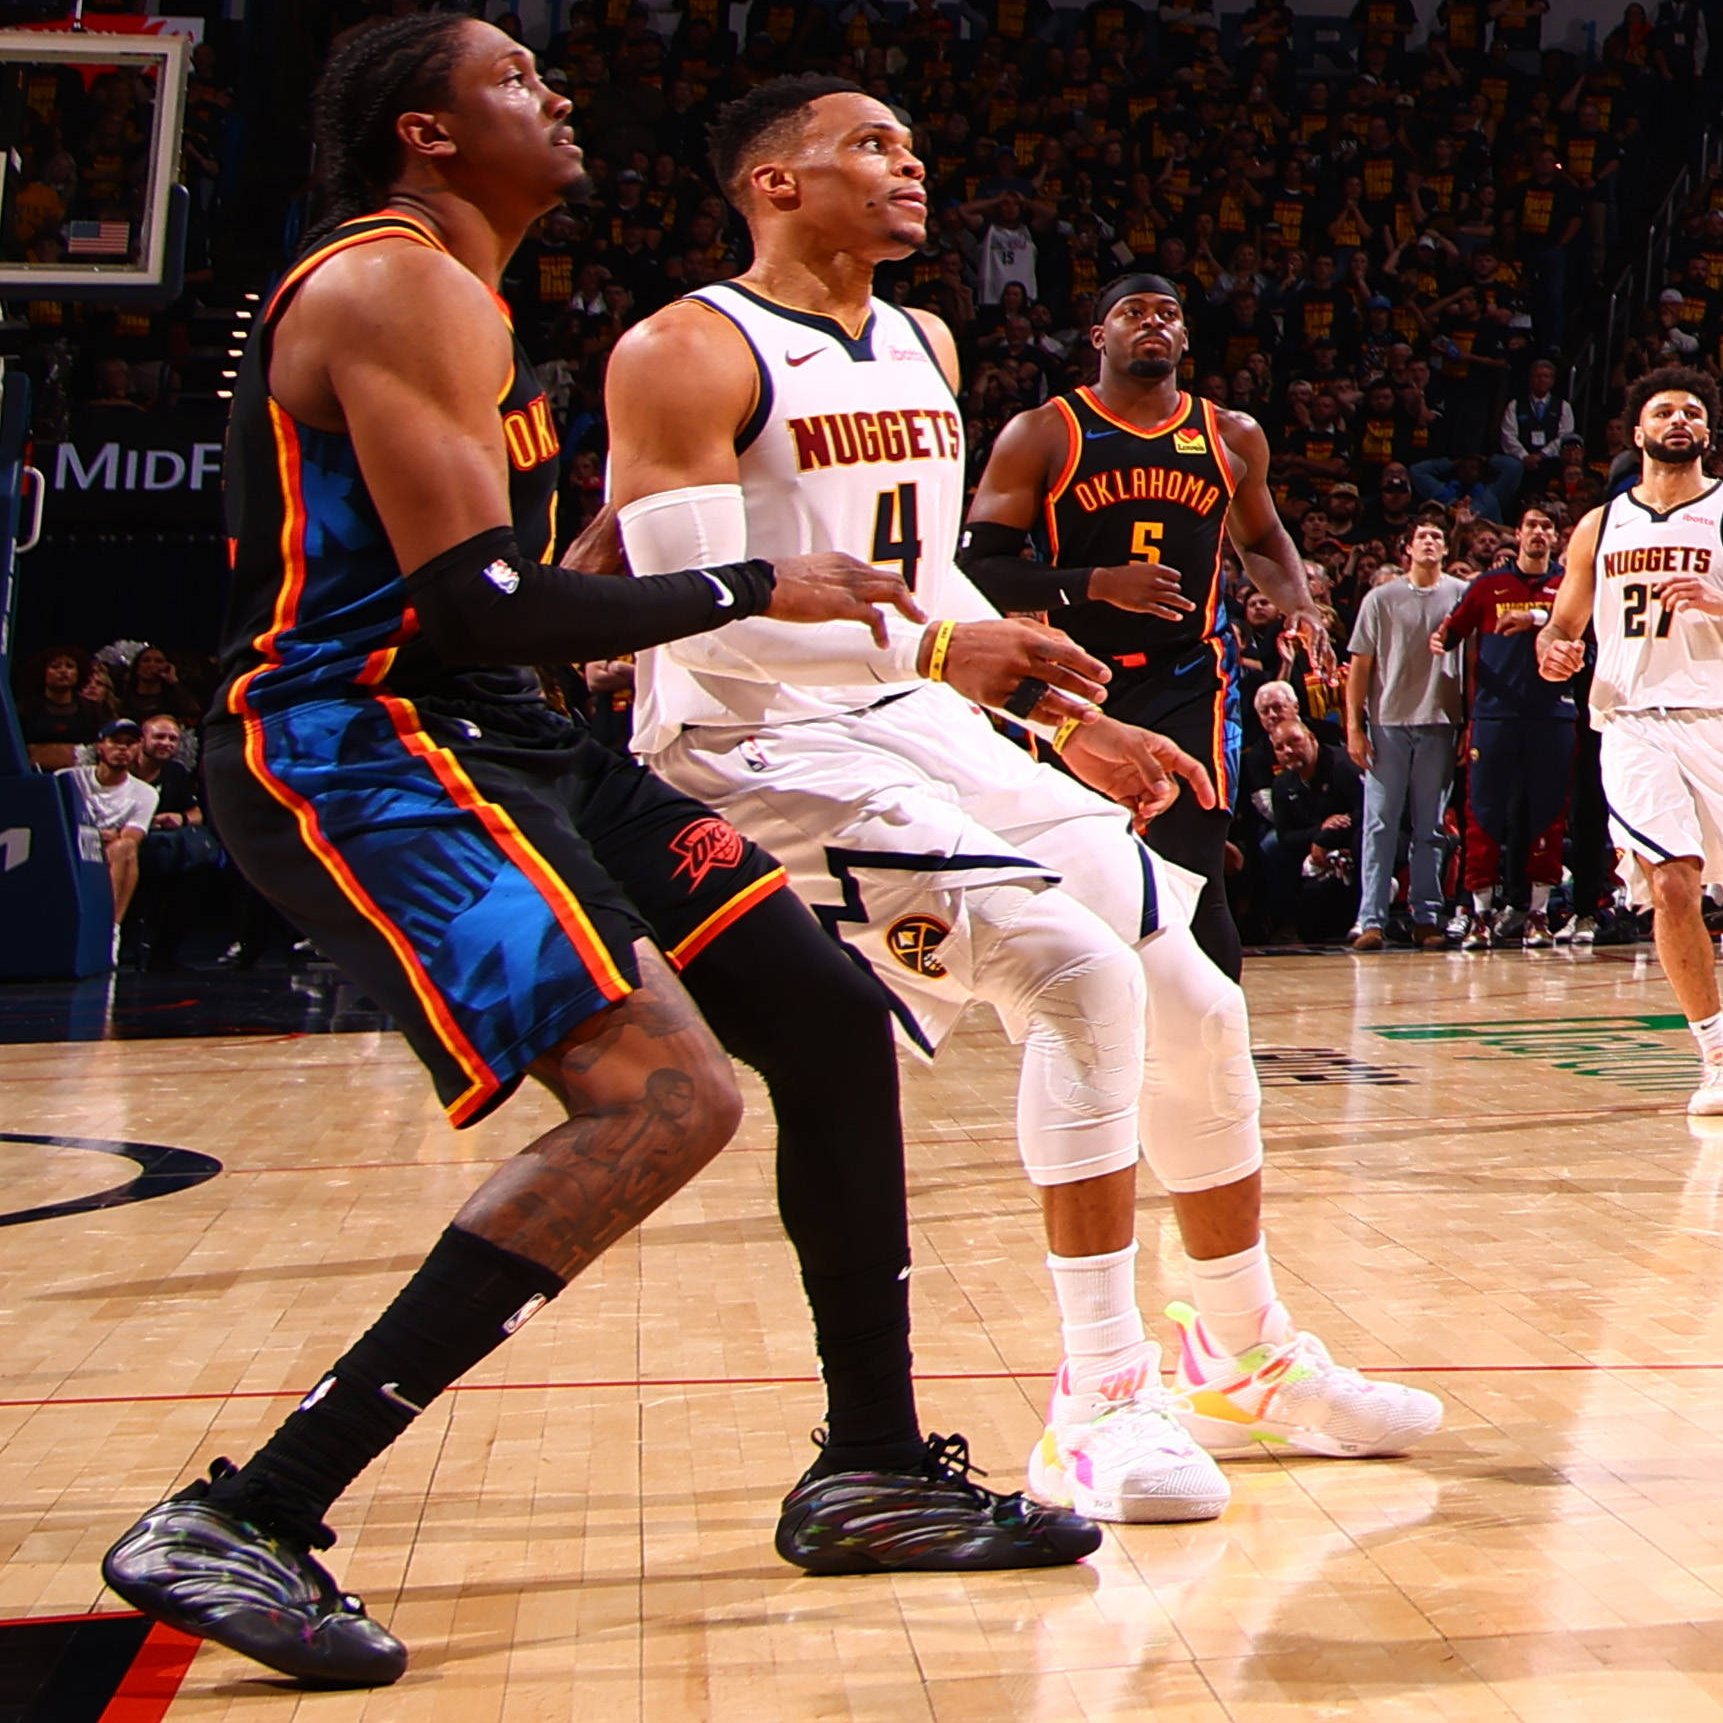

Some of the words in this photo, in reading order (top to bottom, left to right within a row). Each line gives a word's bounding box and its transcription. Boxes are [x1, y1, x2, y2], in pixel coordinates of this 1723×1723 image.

[787, 409, 959, 474] NUGGETS
[1073, 466, 1220, 517] OKLAHOMA
[871, 481, 922, 597] 4
[1129, 520, 1165, 566] 5
[1602, 546, 1713, 579] NUGGETS
[1622, 582, 1675, 640] 27
